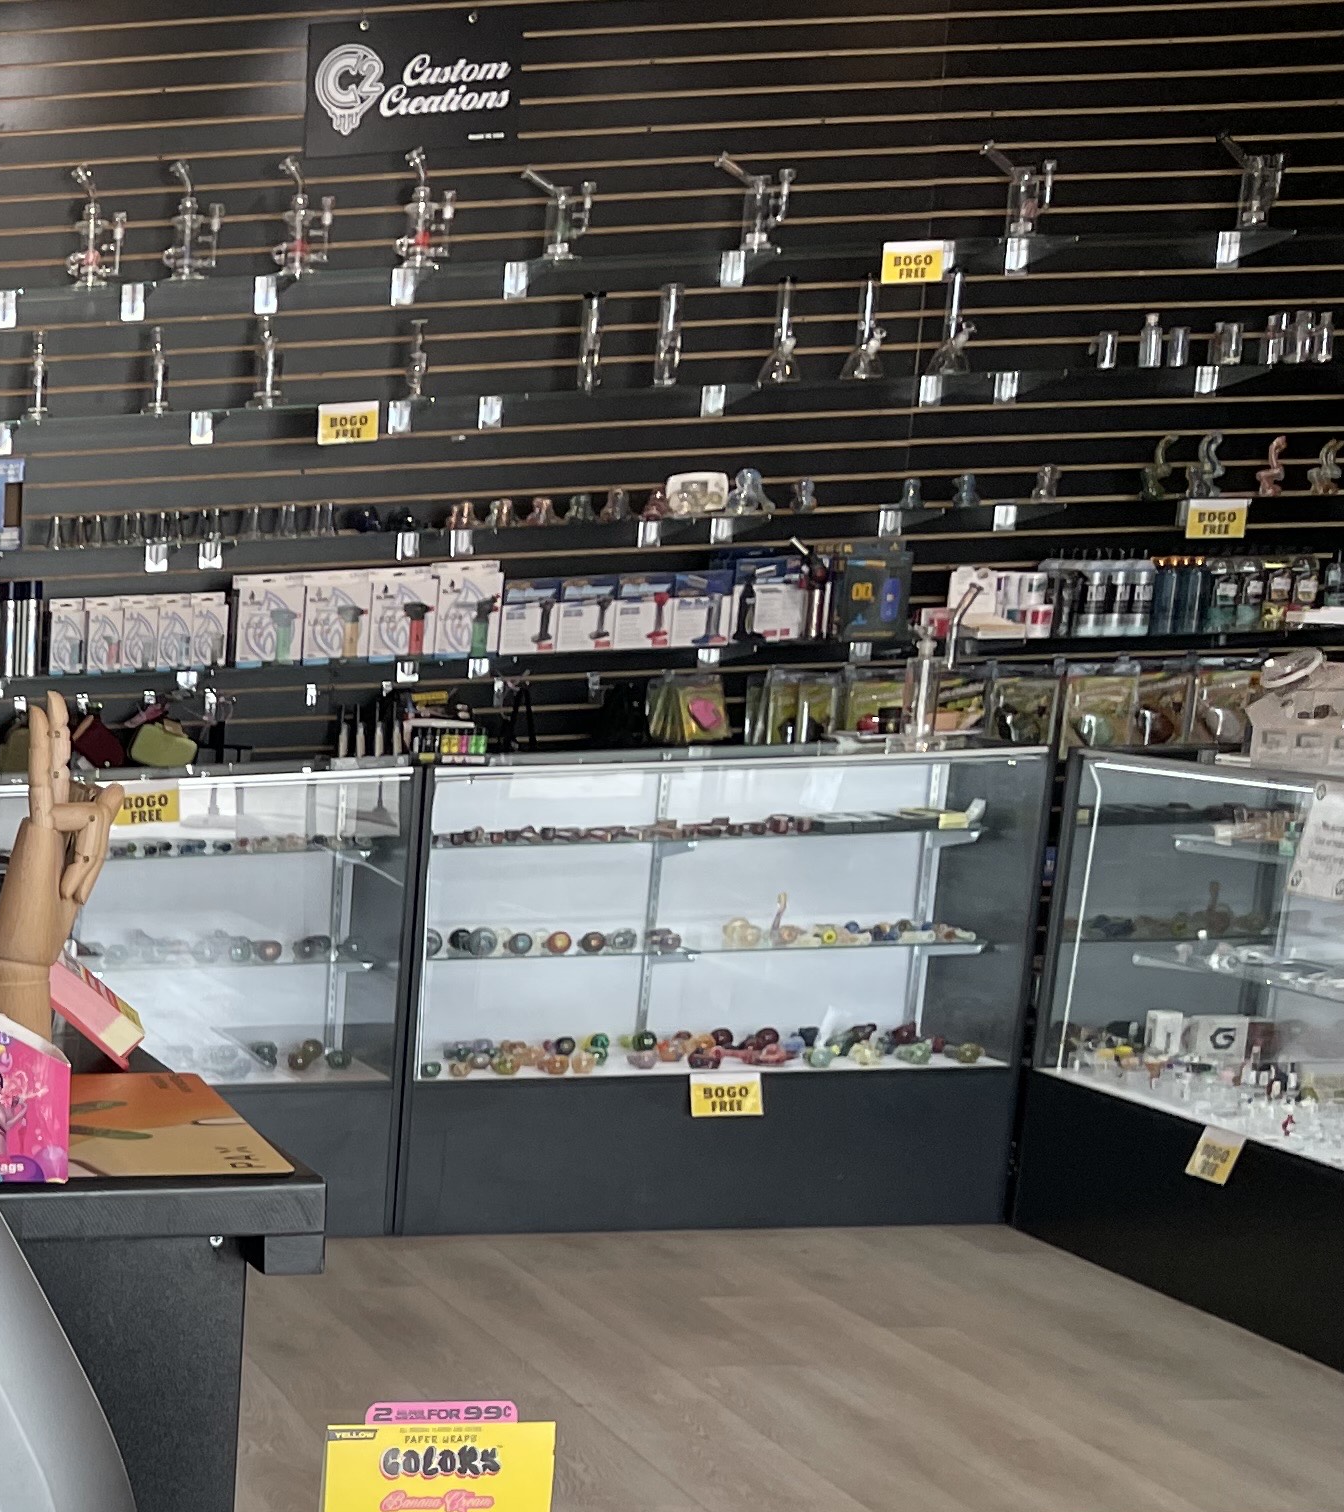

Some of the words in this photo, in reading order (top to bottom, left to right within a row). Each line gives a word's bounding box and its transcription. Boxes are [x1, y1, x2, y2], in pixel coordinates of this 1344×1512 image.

[403, 53, 512, 87] Custom
[379, 84, 511, 118] Creations
[894, 254, 934, 271] BOGO
[898, 268, 927, 280] FREE
[331, 415, 368, 432] BOGO
[335, 427, 363, 440] FREE
[1198, 509, 1237, 526] BOGO
[1202, 522, 1230, 537] FREE
[122, 794, 170, 812] BOGO
[130, 808, 163, 824] FREE
[702, 1084, 750, 1102] BOGO
[709, 1098, 745, 1115] FREE
[380, 1446, 502, 1480] COLORS
